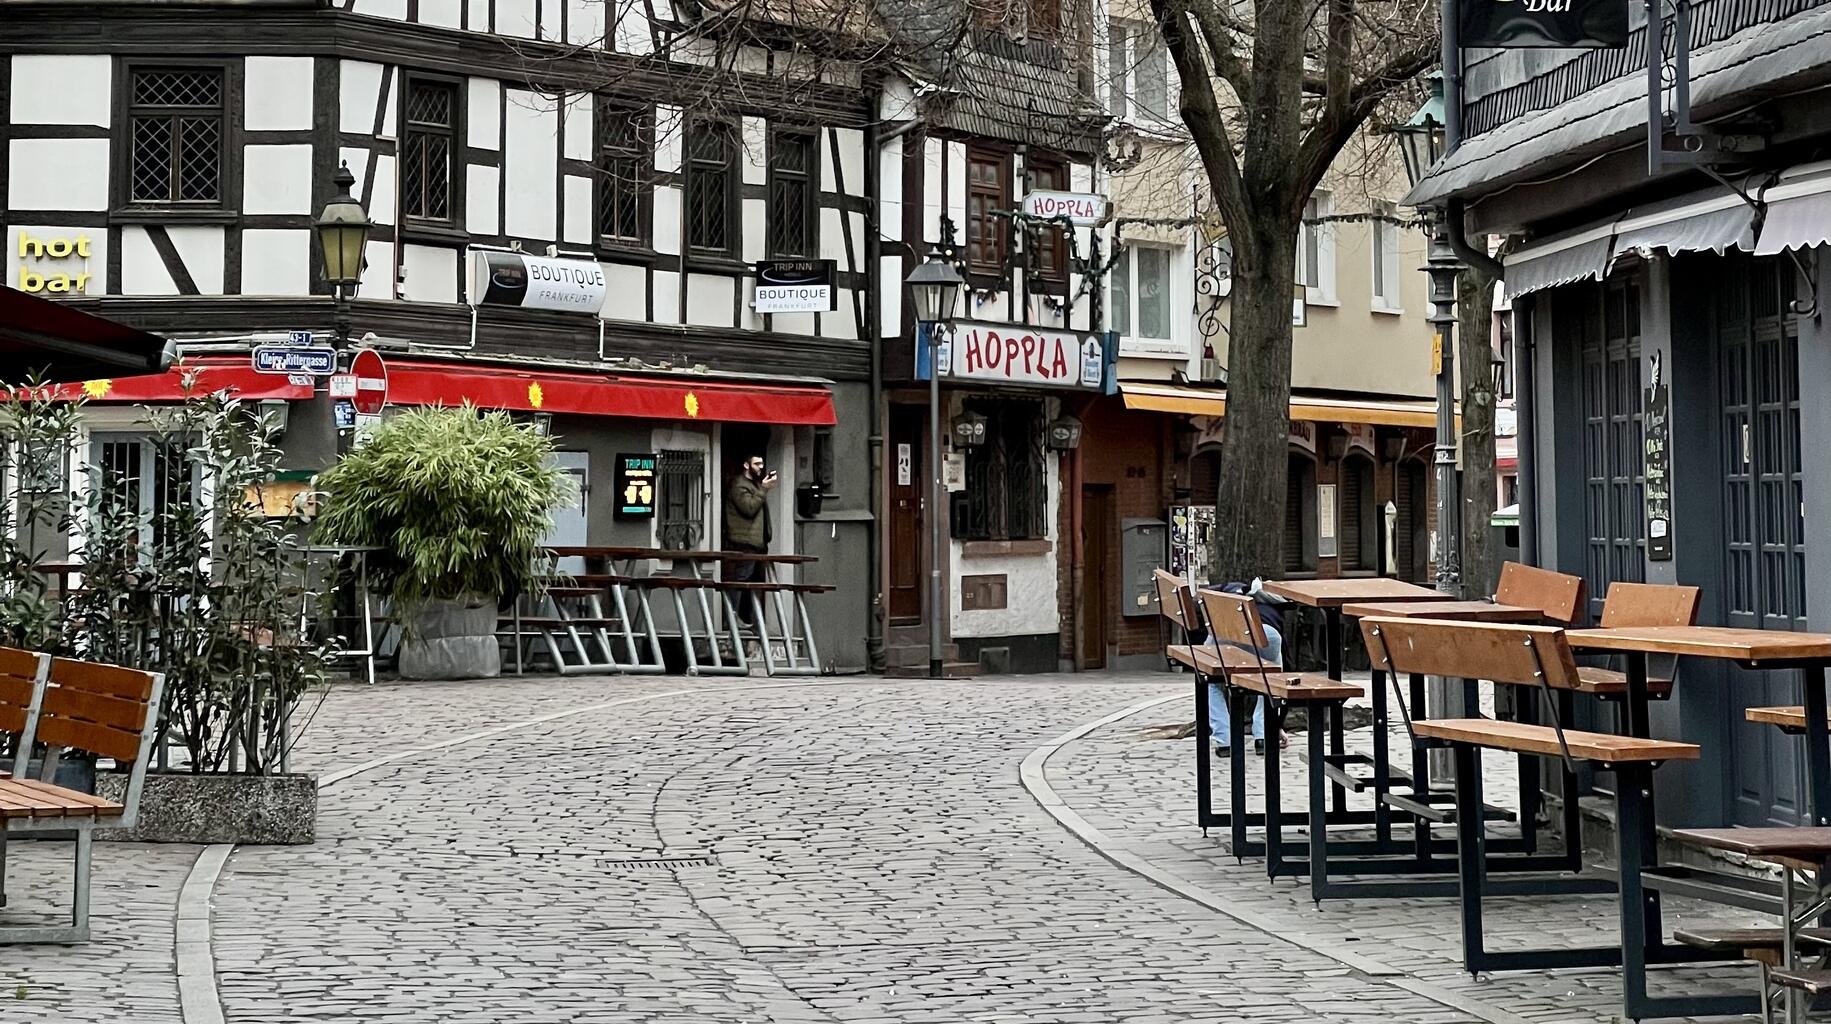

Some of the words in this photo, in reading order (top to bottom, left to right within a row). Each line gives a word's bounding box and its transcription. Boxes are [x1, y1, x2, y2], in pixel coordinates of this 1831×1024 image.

[1033, 197, 1095, 218] HOPPLA
[18, 230, 92, 258] hot
[530, 264, 604, 290] BOUTIQUE
[773, 262, 794, 272] TRIP
[795, 262, 813, 271] INN
[19, 266, 92, 293] bar
[539, 290, 594, 305] FRANKFURT
[759, 288, 827, 301] BOUTIQUE
[965, 328, 1068, 380] HOPPLA
